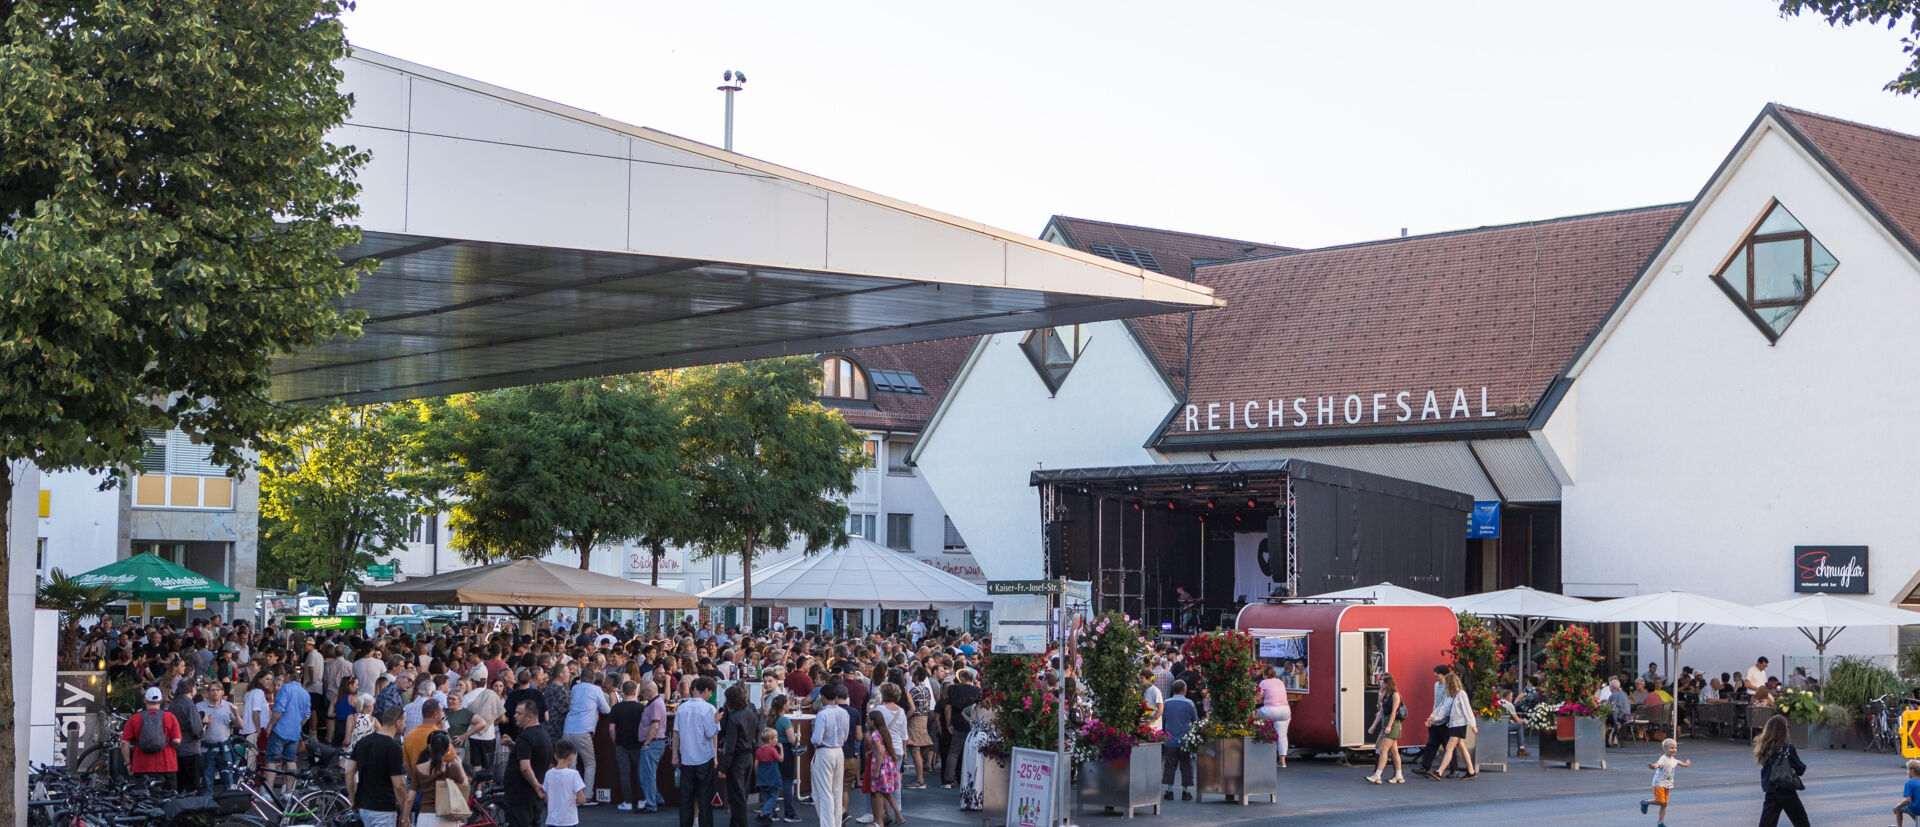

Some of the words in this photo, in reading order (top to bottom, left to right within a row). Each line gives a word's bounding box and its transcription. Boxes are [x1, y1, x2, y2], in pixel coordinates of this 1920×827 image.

[1185, 386, 1496, 432] REICHSHOFSAAL
[1796, 551, 1864, 588] Schmugglar
[148, 576, 209, 588] Mohrenbräu
[995, 582, 1059, 592] Kaiser-Fr.-Josef-Str.
[1017, 763, 1042, 781] -25%
